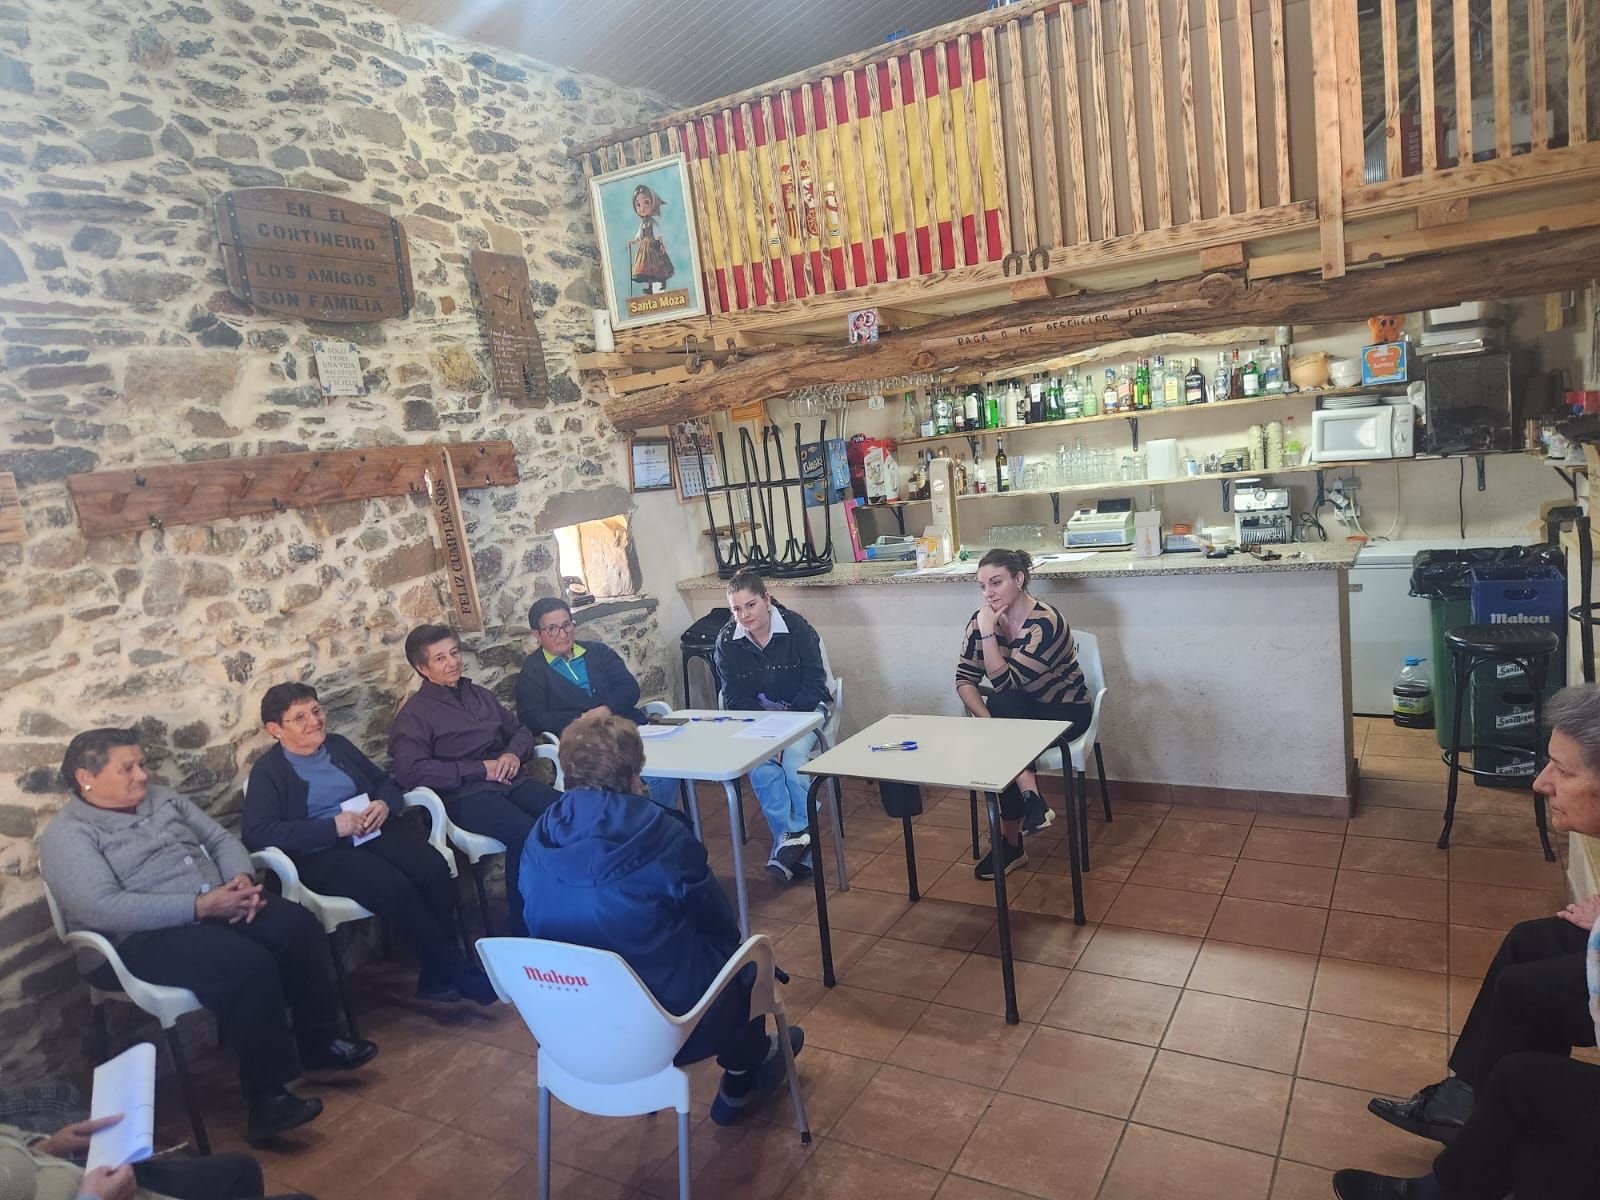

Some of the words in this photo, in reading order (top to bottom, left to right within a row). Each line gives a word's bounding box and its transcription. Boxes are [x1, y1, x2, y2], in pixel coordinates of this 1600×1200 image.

[286, 201, 312, 218] EN
[329, 207, 353, 224] EL
[257, 222, 376, 251] CORTINEIRO
[255, 261, 297, 279] LOS
[308, 268, 377, 288] AMIGOS
[258, 291, 299, 306] SON
[309, 294, 384, 313] FAMILIA
[630, 299, 658, 313] Santa
[660, 295, 686, 308] Moza
[957, 332, 989, 346] PAGA
[1019, 326, 1034, 336] ME
[434, 478, 465, 573] CUMPLEAÑOS
[454, 575, 472, 615] FELIZ
[1490, 612, 1550, 624] Mahou
[523, 966, 589, 986] Mahou
